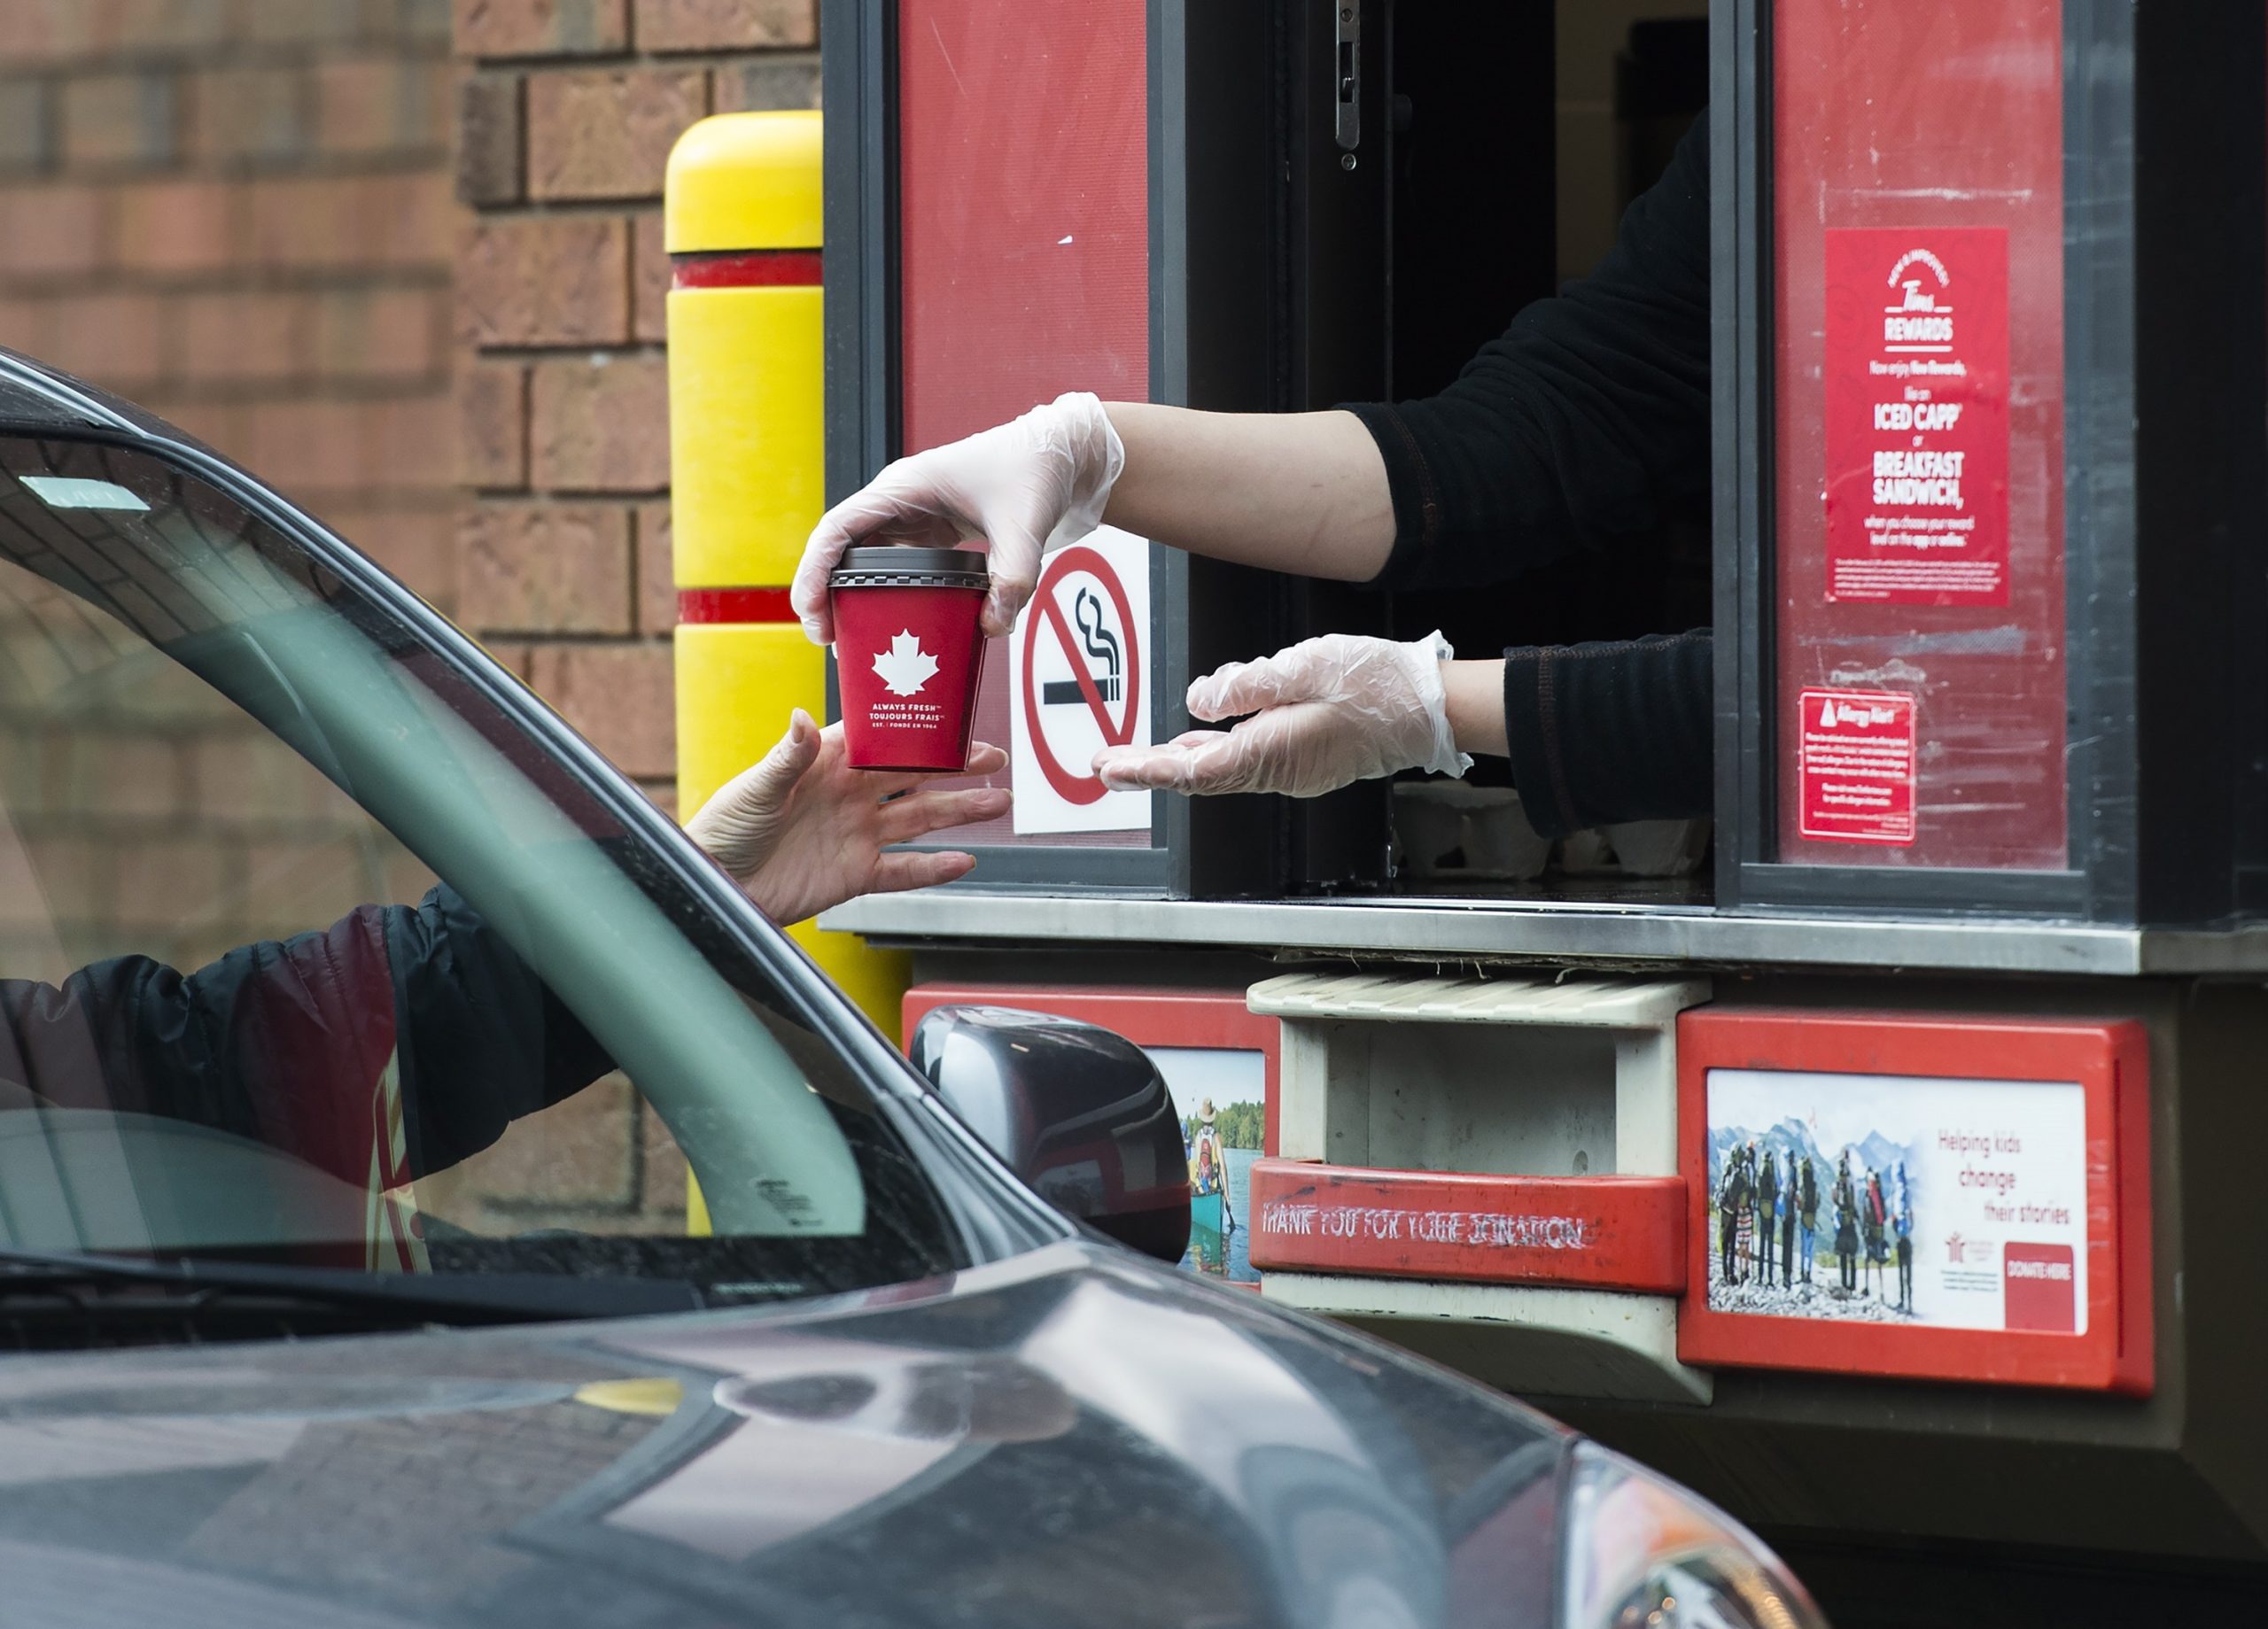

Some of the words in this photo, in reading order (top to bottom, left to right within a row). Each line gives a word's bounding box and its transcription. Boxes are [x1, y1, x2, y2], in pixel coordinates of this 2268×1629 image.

[1884, 317, 1953, 342] REWARDS
[1874, 403, 1913, 431] ICED
[1873, 451, 1965, 478] BREAKFAST
[1872, 478, 1964, 510] SANDWICH,
[1938, 1129, 1992, 1159] Helping
[1994, 1129, 2022, 1153] kids
[1959, 1163, 2017, 1196] change
[1984, 1200, 2016, 1222] their
[2019, 1198, 2071, 1225] stories
